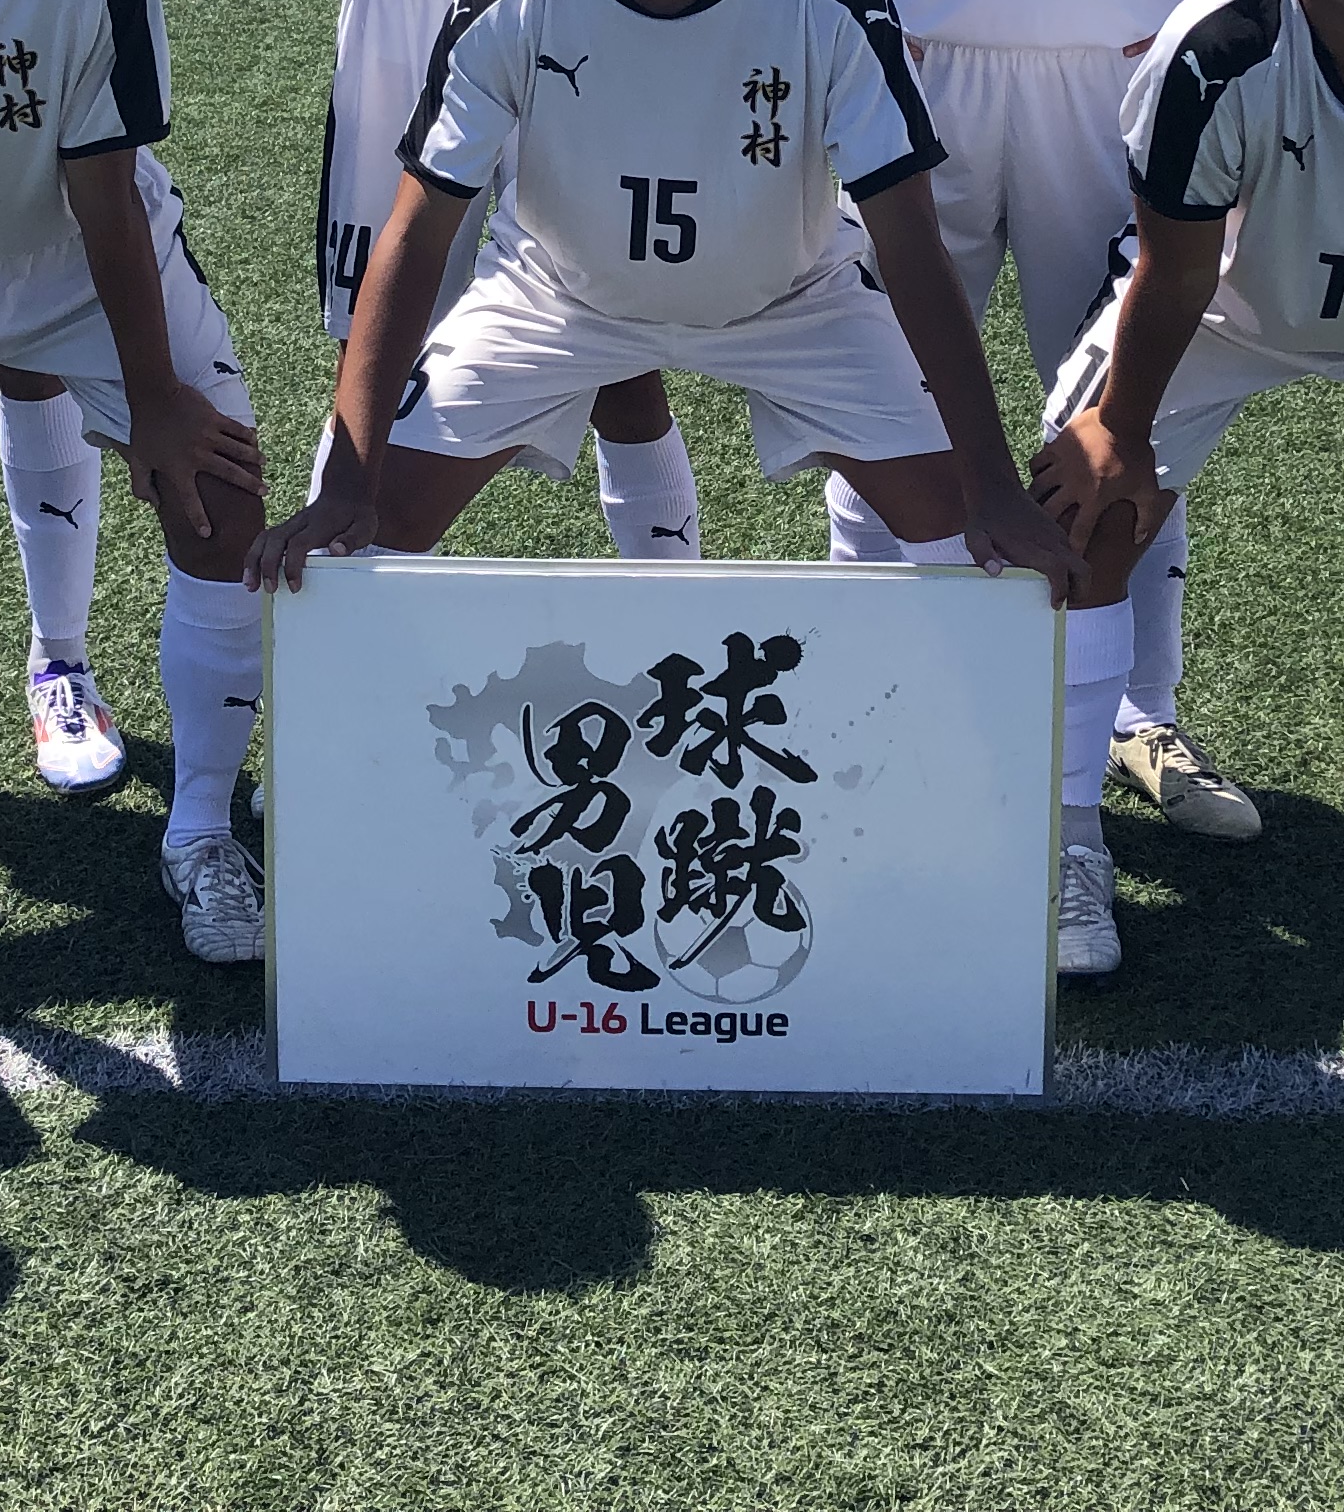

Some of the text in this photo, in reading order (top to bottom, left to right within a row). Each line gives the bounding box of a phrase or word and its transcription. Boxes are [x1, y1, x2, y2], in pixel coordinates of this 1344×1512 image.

[740, 66, 791, 168] 神村
[619, 174, 698, 264] 15
[527, 1001, 789, 1044] U-16 League
